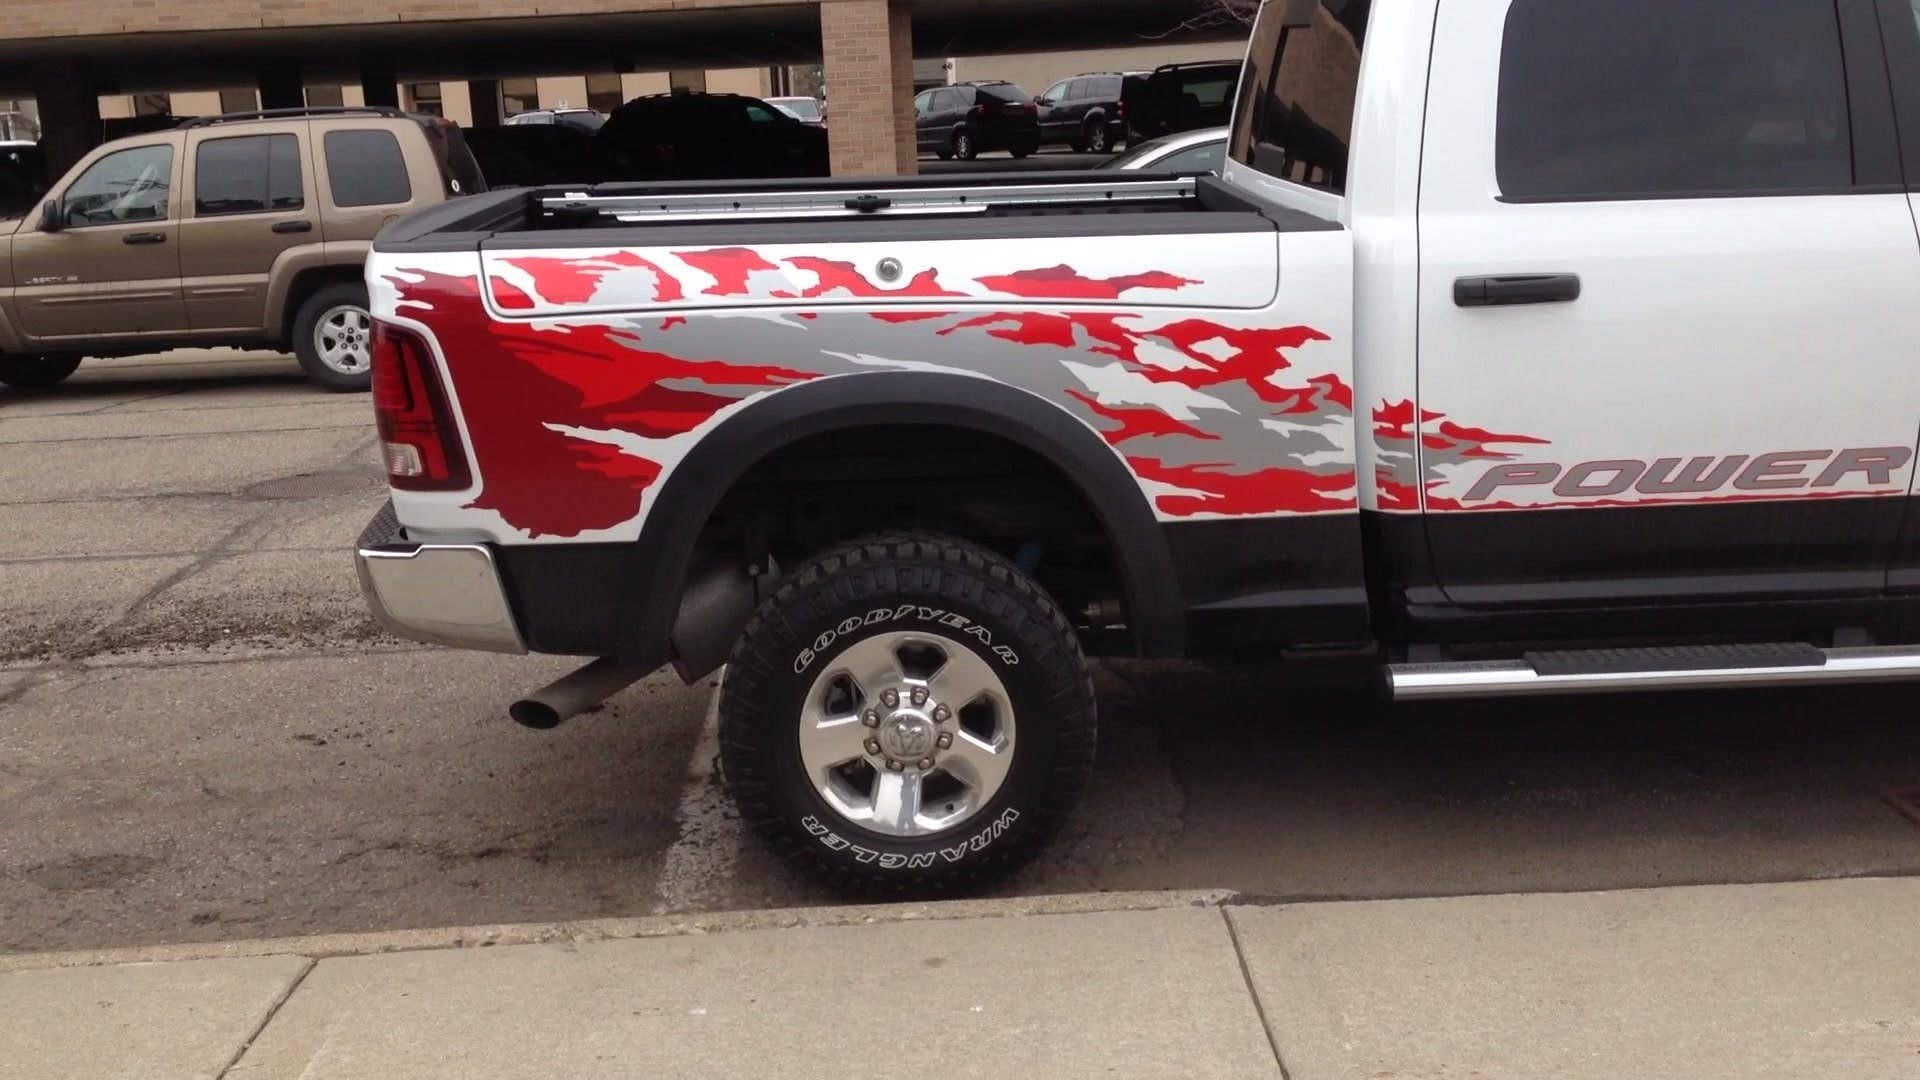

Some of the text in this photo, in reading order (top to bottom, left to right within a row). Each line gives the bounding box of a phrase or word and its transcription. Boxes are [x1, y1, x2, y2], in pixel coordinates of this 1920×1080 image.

[1461, 446, 1912, 501] POWER
[794, 605, 1019, 674] GOODYEAR
[801, 807, 1020, 868] WRANGLER
